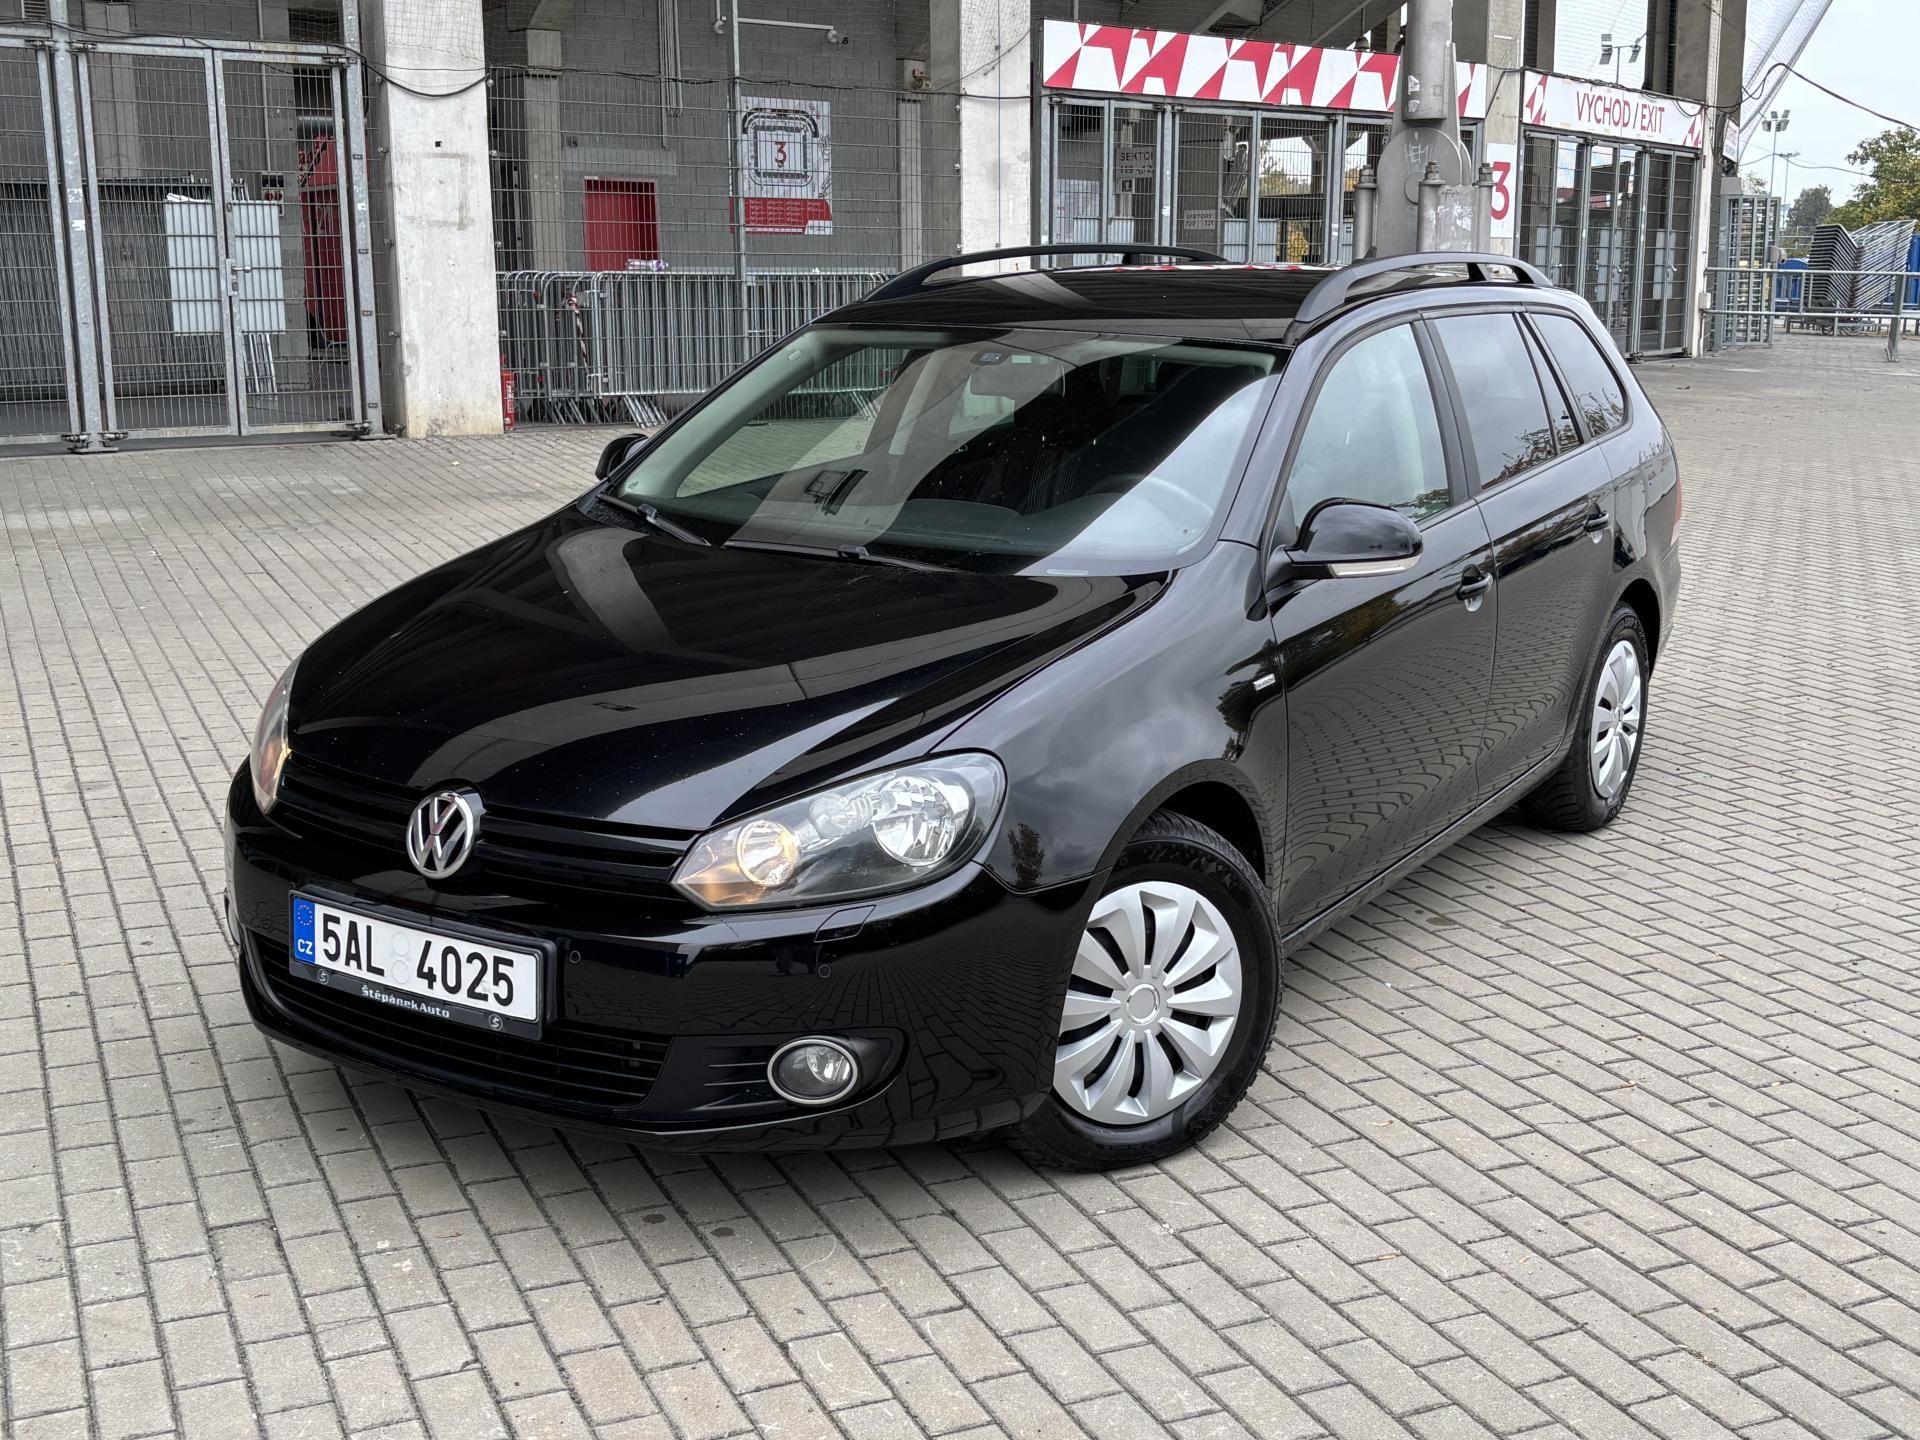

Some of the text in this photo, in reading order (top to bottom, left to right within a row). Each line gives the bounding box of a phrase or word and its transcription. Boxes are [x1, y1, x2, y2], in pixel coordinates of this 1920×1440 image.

[1577, 87, 1631, 127] VÝCHOD
[1641, 104, 1665, 134] EXIT
[1491, 161, 1511, 221] 3
[297, 938, 313, 955] CZ
[322, 912, 514, 1007] 5AL 4025
